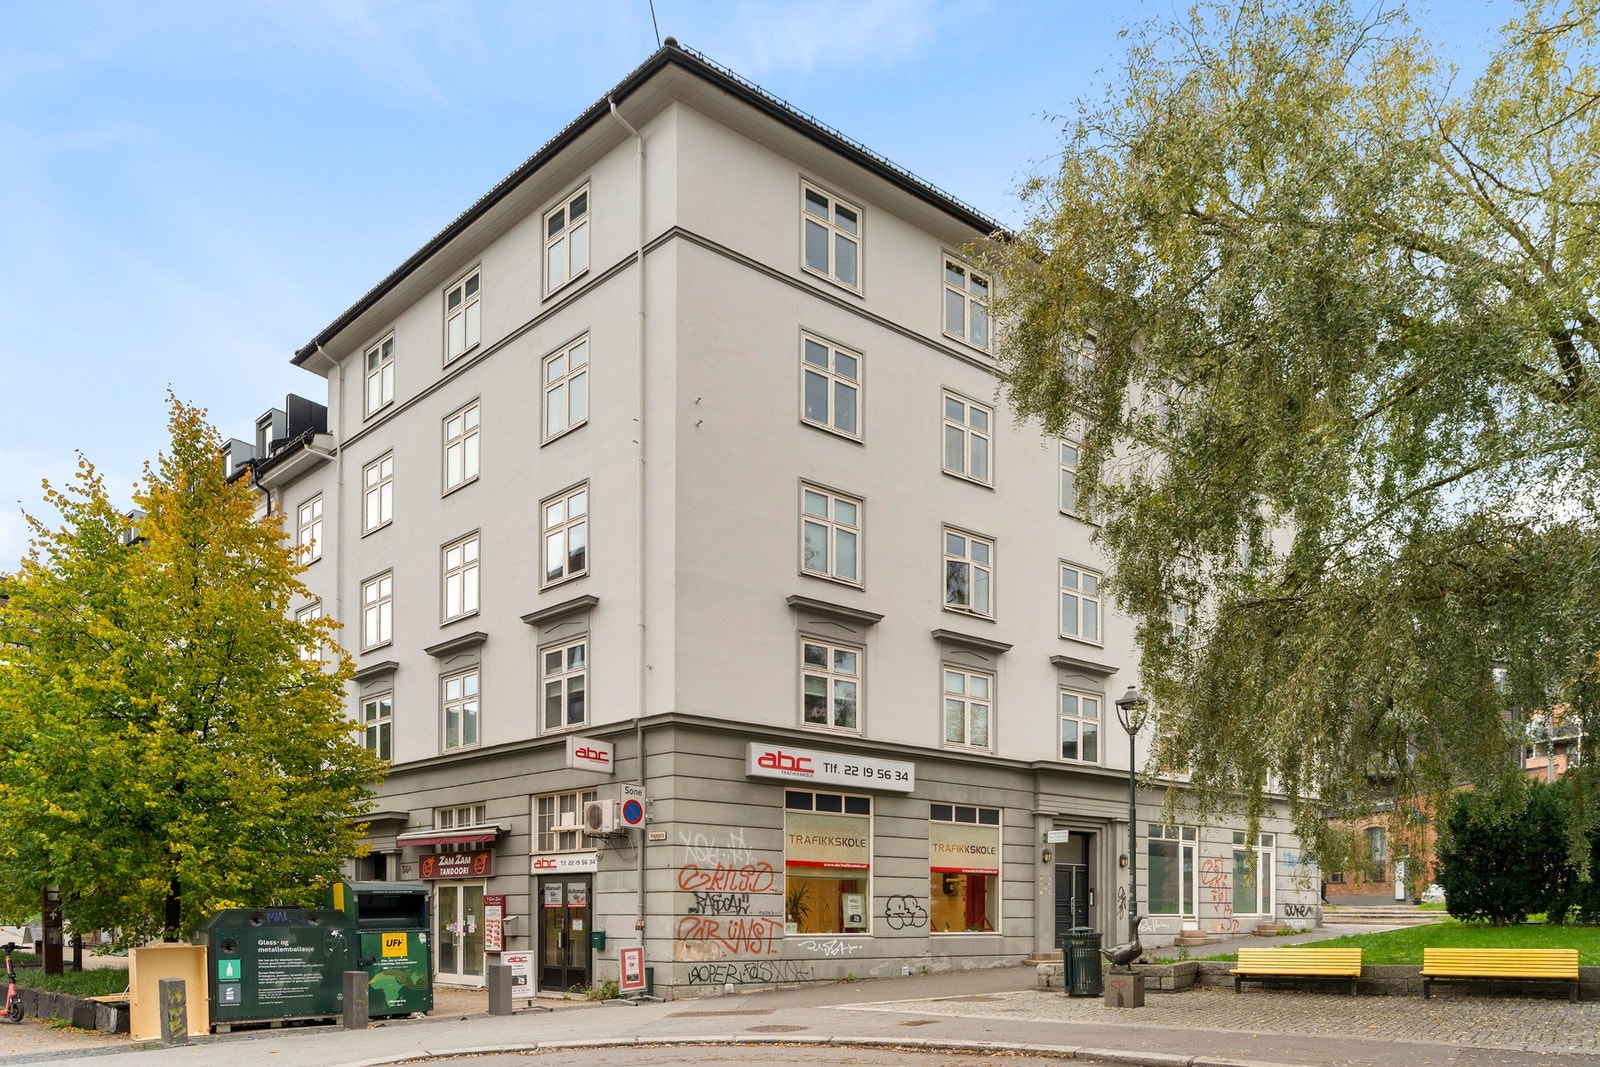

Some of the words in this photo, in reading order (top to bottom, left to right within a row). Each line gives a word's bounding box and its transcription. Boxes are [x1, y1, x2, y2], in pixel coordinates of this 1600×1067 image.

[575, 747, 610, 762] abc
[757, 750, 815, 773] abc
[823, 762, 840, 774] Tlf.
[844, 765, 859, 776] 22
[863, 767, 873, 778] 19
[877, 769, 892, 780] 56
[895, 771, 909, 782] 34
[781, 770, 813, 778] TRAFIKKSKOLE
[625, 786, 642, 796] Sone
[789, 834, 866, 848] TRAFIKKSKOLE
[933, 843, 996, 855] TRAFIKKSKOLE
[438, 856, 454, 866] ZAM
[455, 854, 471, 865] ZAM
[533, 858, 557, 869] abc
[440, 867, 469, 875] TANDOORI
